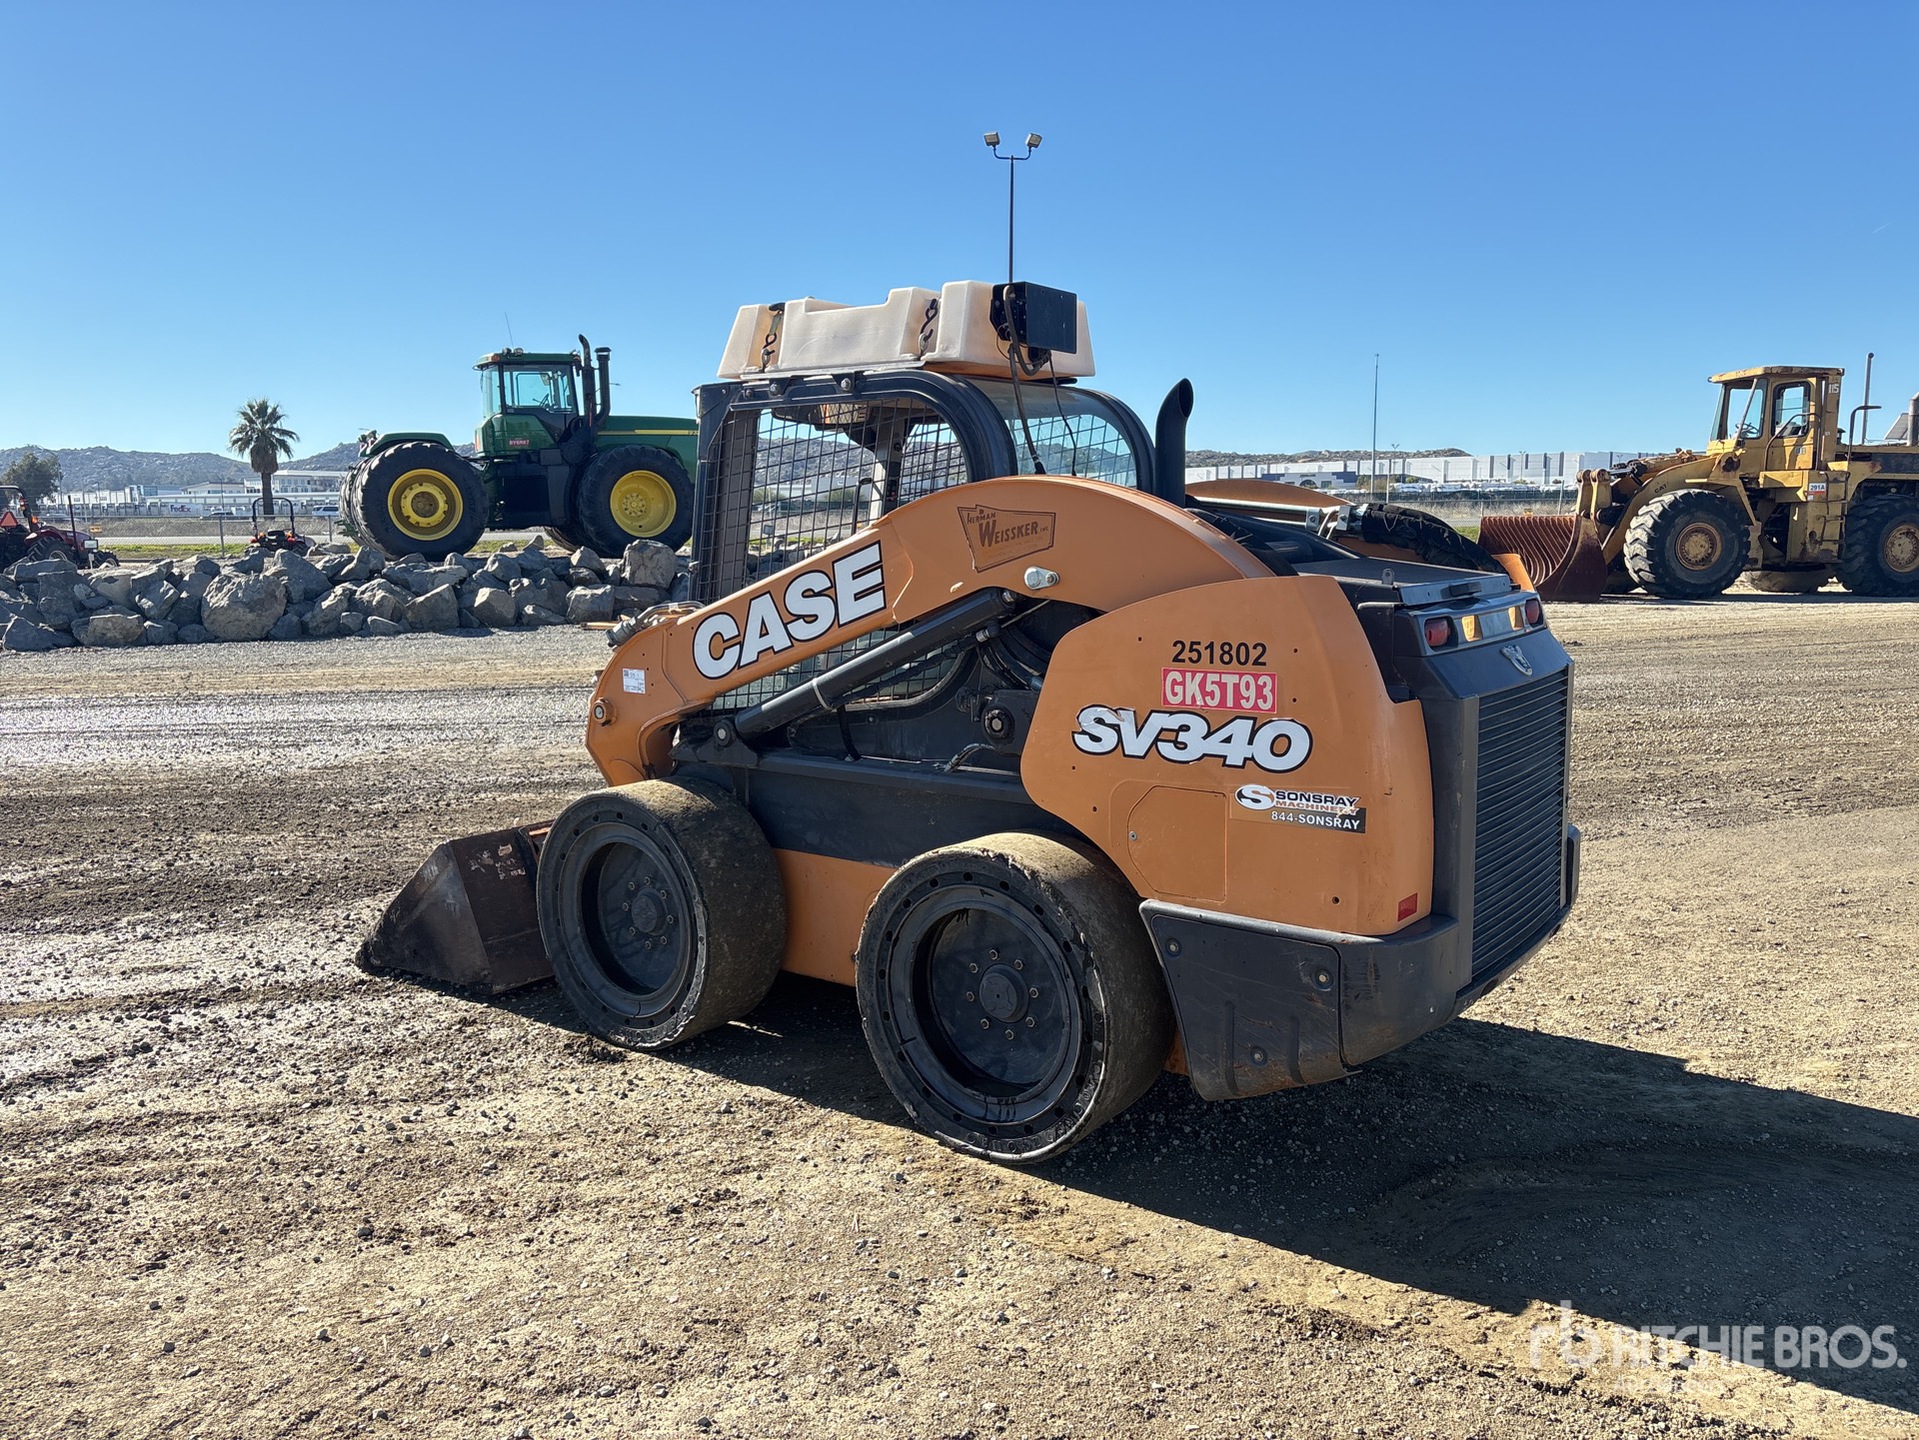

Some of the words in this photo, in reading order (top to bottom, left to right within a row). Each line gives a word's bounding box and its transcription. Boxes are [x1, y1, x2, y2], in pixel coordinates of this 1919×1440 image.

[170, 504, 191, 513] FedEx
[979, 520, 1039, 547] WEISSKER
[692, 540, 887, 680] CASE
[1172, 640, 1267, 666] 251802
[1165, 671, 1273, 710] GK5T93
[1072, 704, 1313, 773] SV340
[1276, 790, 1359, 806] SONSRAY
[1271, 811, 1359, 829] 844-SONSRAY
